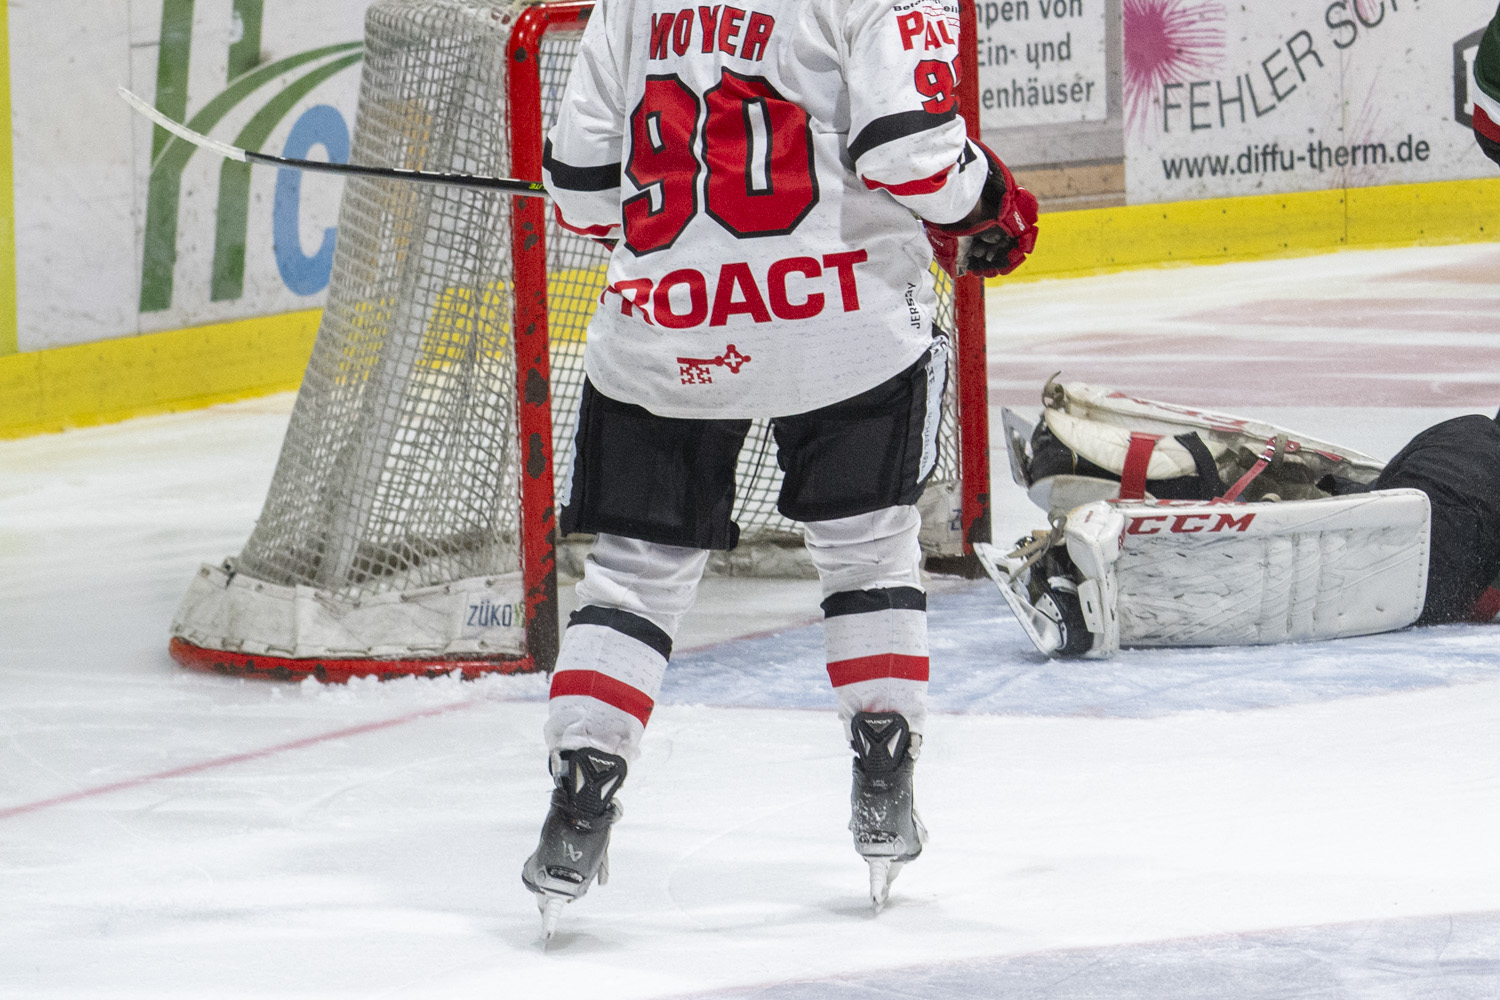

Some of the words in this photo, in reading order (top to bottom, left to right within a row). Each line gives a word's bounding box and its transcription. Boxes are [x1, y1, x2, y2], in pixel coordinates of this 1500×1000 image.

[648, 4, 776, 63] MOYER
[1026, 31, 1072, 64] und
[913, 58, 962, 115] 9
[982, 77, 1095, 110] enhäuser
[1161, 29, 1325, 134] FEHLER
[621, 64, 821, 258] 90
[1162, 136, 1432, 181] www.diffu-therm.de
[601, 248, 869, 330] ROACT
[1126, 512, 1257, 536] CCM
